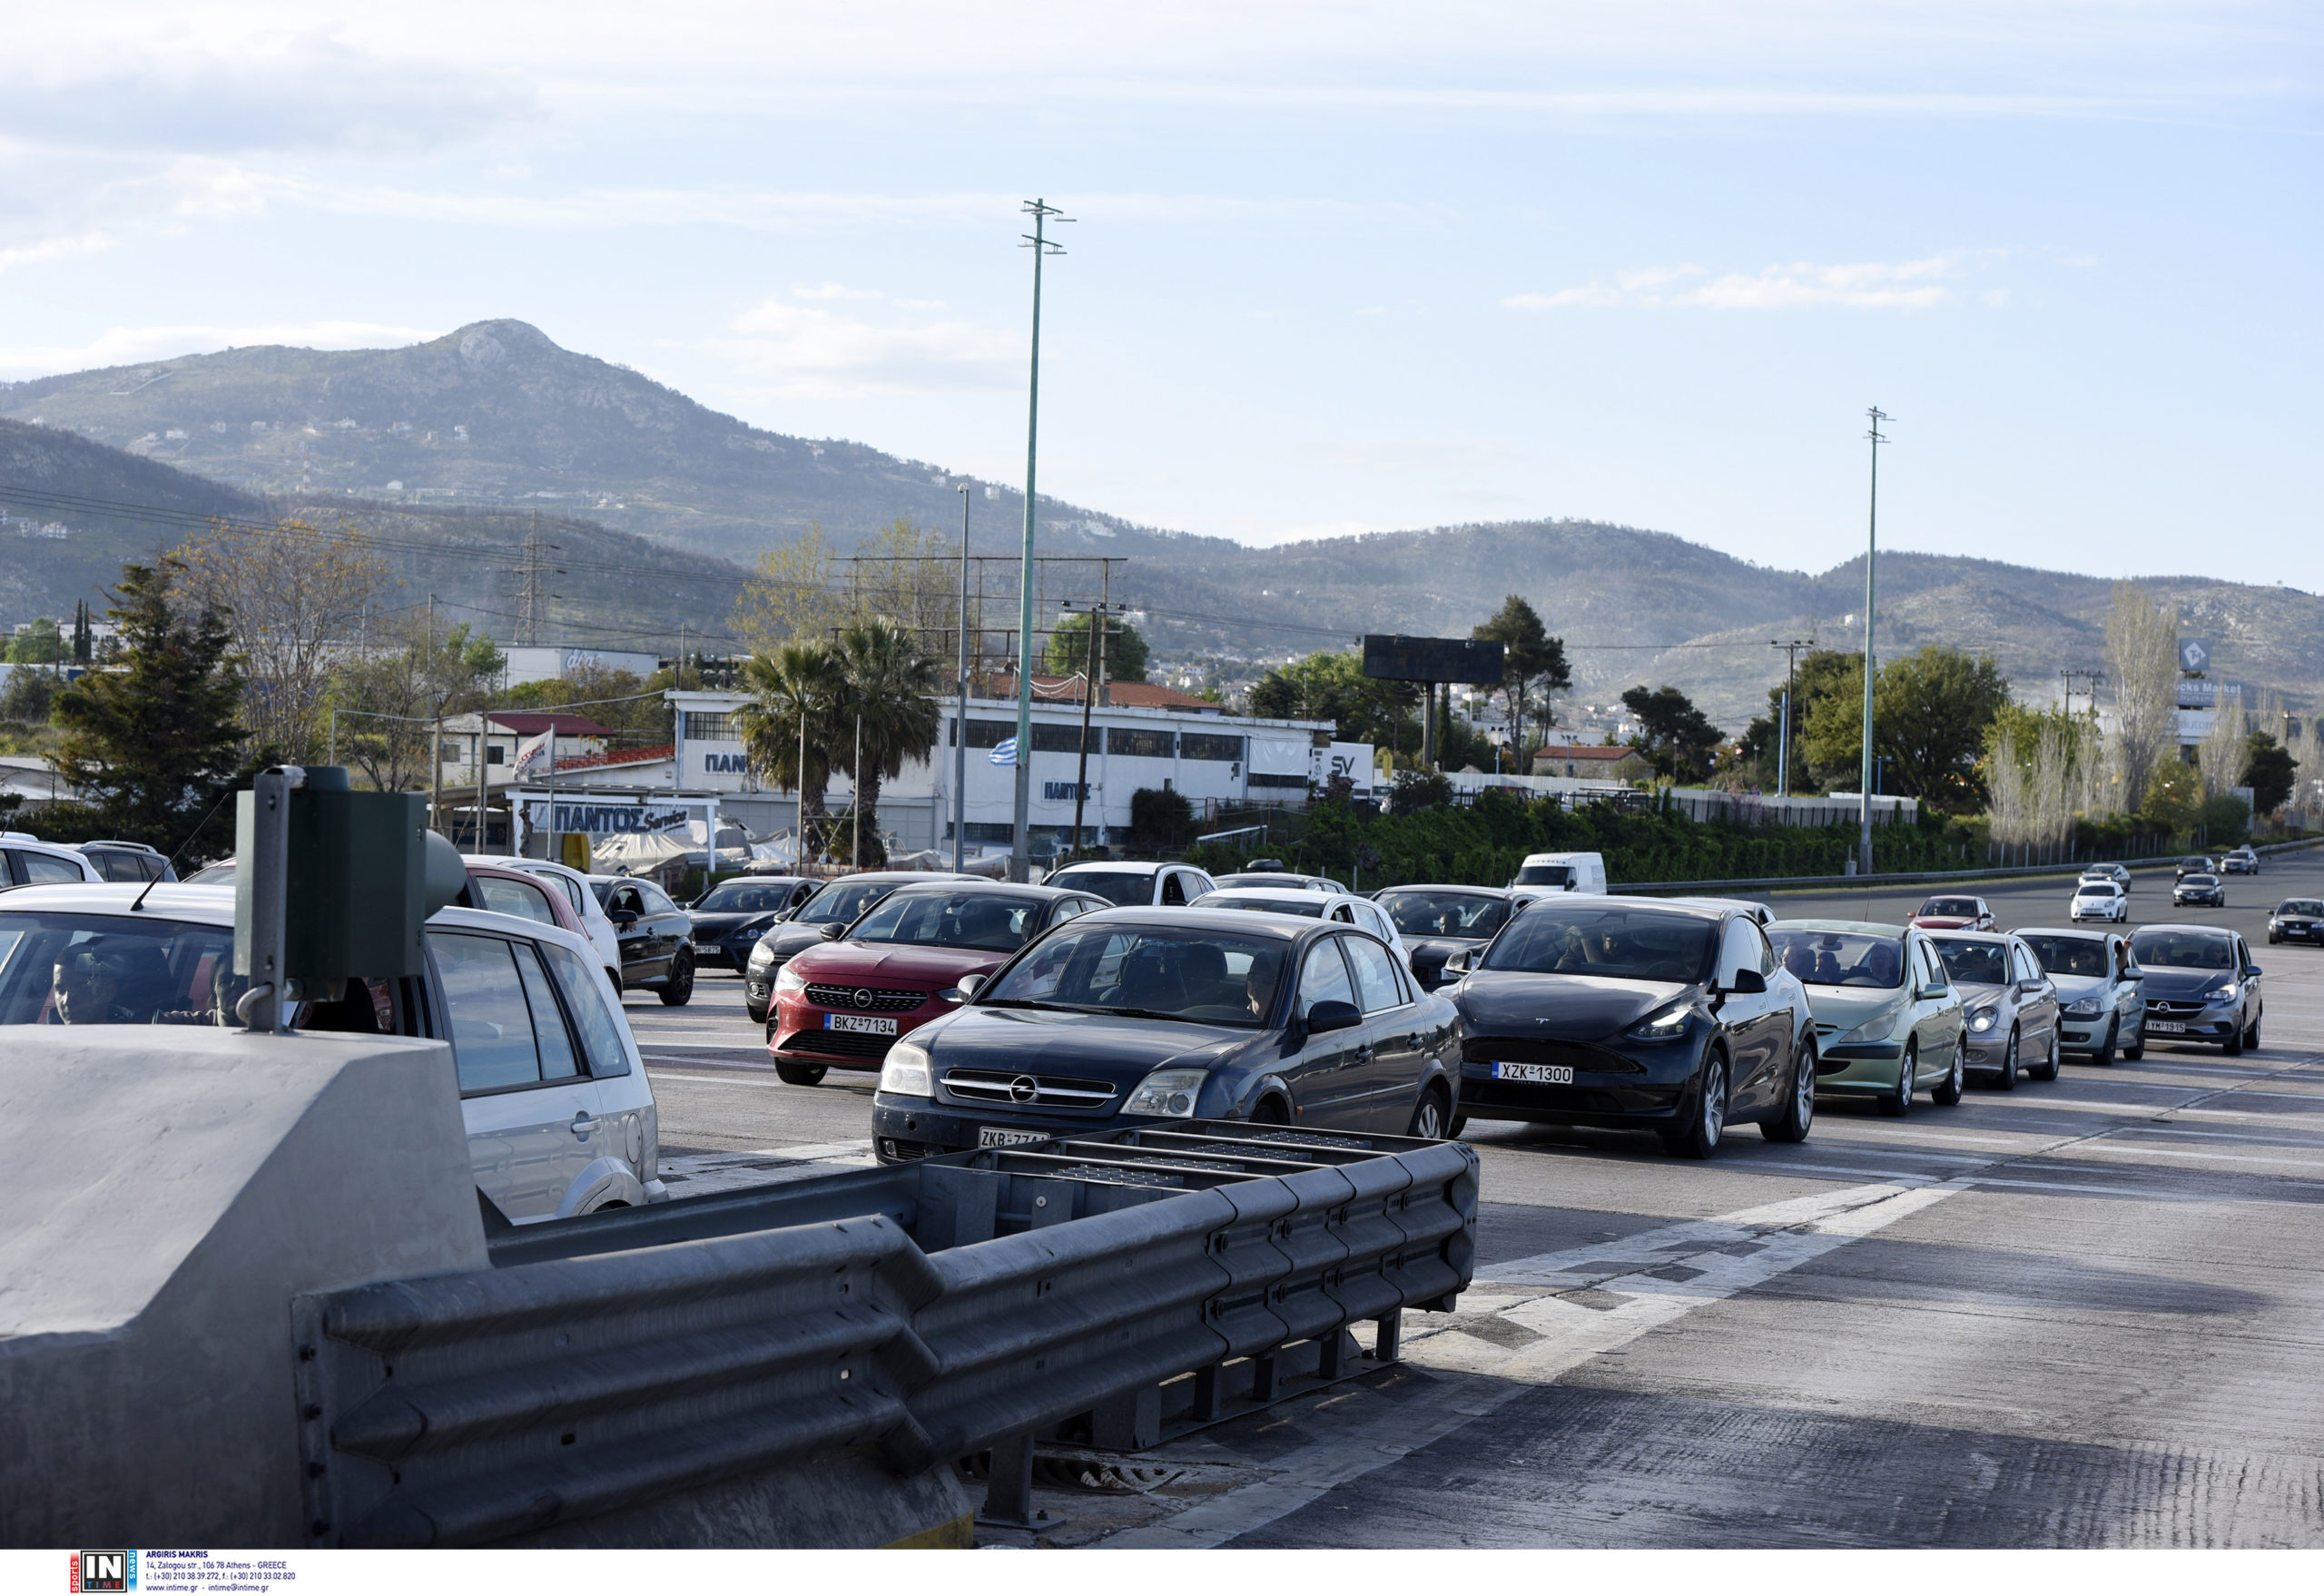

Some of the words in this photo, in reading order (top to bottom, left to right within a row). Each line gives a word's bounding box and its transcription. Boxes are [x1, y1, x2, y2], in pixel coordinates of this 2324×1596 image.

[2202, 682, 2241, 695] Maket
[705, 754, 746, 773] ΠΑΝ
[1331, 755, 1355, 775] SV
[555, 805, 645, 832] ΠΑΝΤΟΣ
[645, 810, 687, 831] Service
[834, 1016, 894, 1033] BKZ-7134
[1502, 1063, 1571, 1082] XZK-1300
